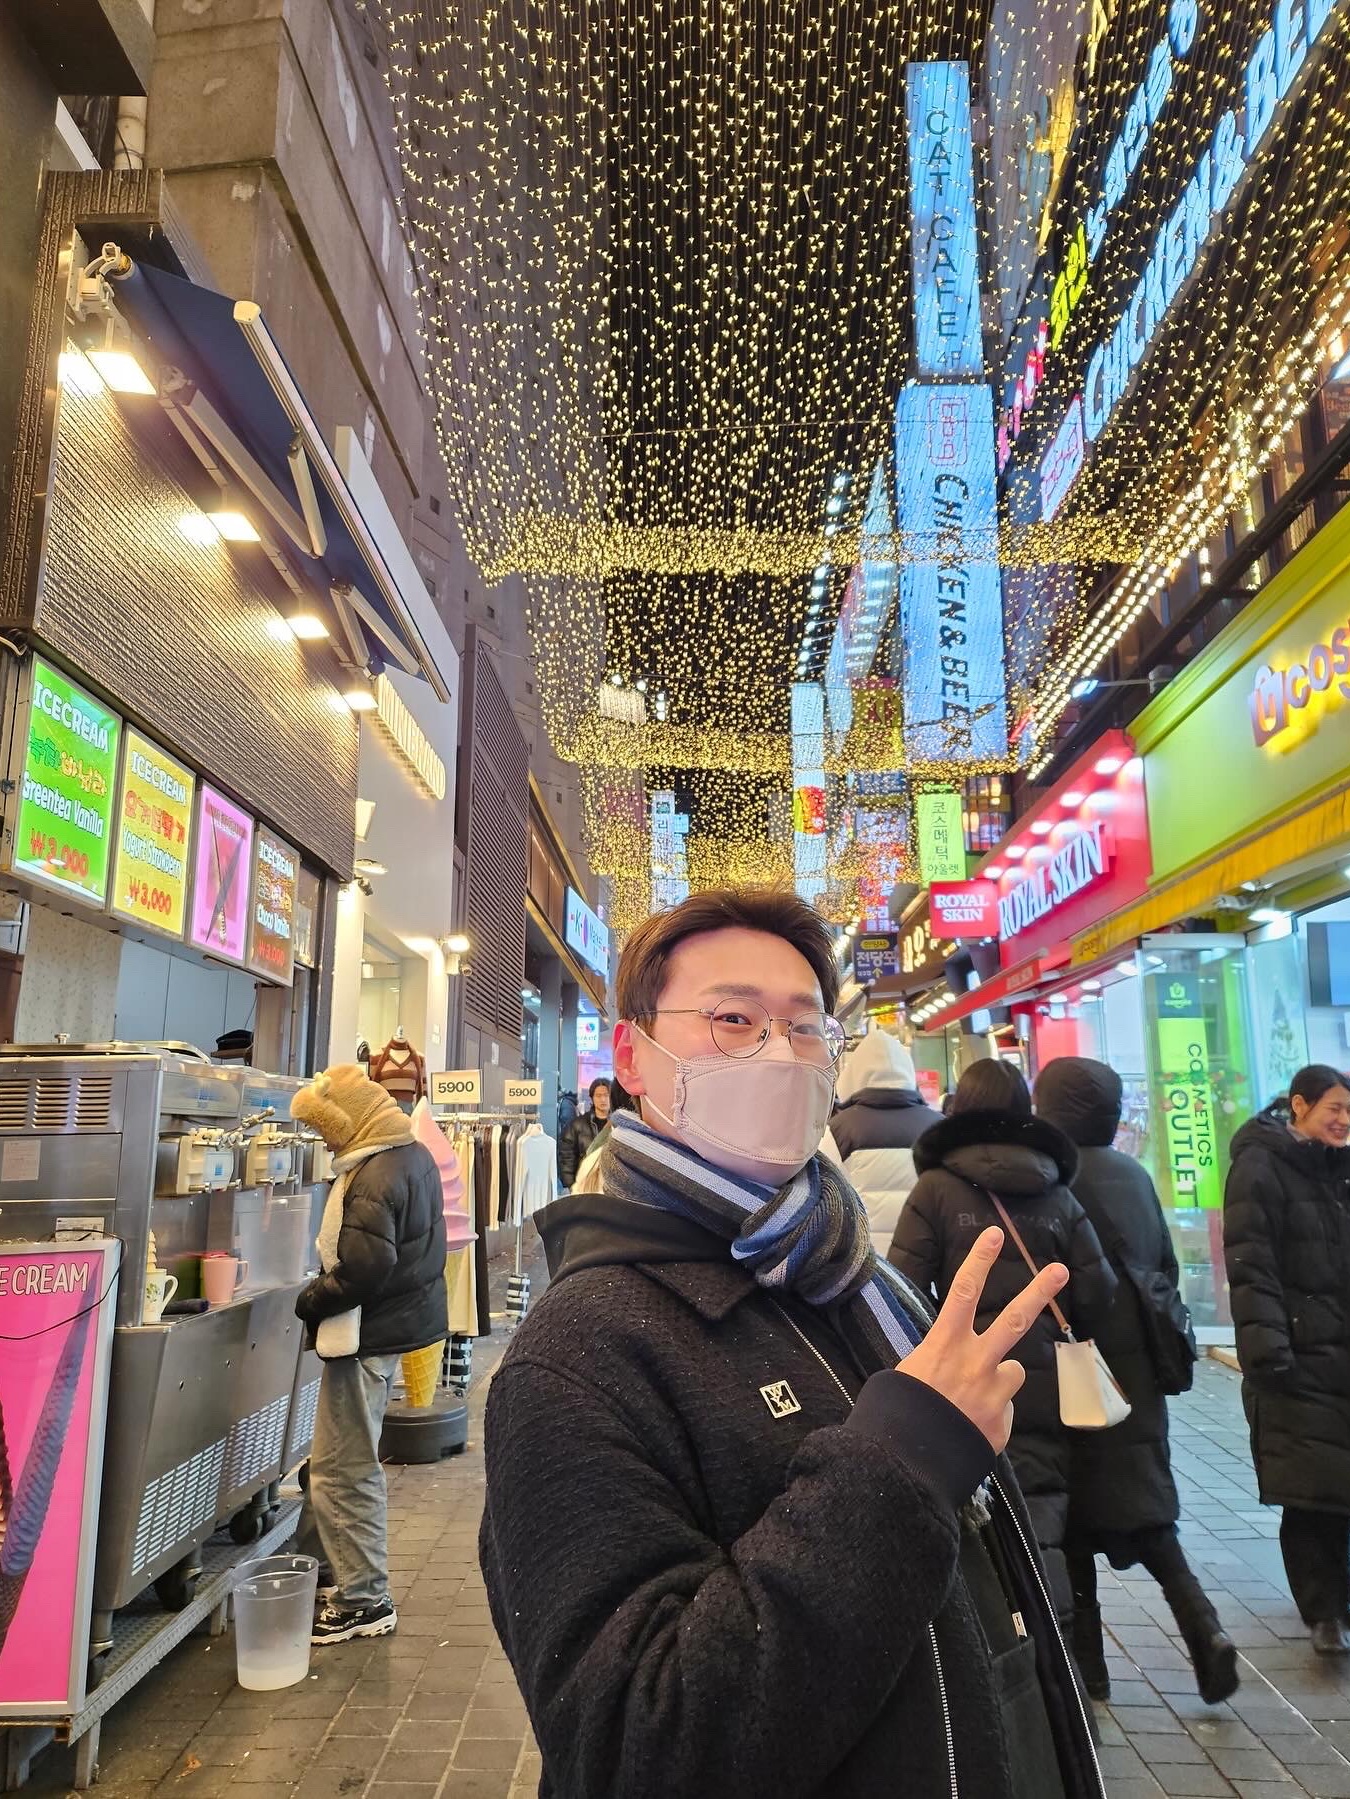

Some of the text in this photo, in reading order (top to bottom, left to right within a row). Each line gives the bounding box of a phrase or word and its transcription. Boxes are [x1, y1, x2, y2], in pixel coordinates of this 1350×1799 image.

[926, 110, 951, 196] CAT
[931, 215, 958, 338] CAFE
[33, 680, 109, 754] ICECREAM
[130, 750, 187, 806] ICECREAM
[73, 800, 104, 839] Vanilla
[931, 801, 949, 860] 코스메틱
[927, 864, 959, 876] 아울렛
[998, 821, 1106, 942] ROYAL SKIN
[934, 894, 990, 909] ROYAL
[941, 908, 983, 922] SKIN
[438, 1081, 474, 1093] 5900
[508, 1087, 537, 1097] 5900
[1169, 1088, 1199, 1208] OUTLET
[11, 1262, 89, 1297] CREAM
